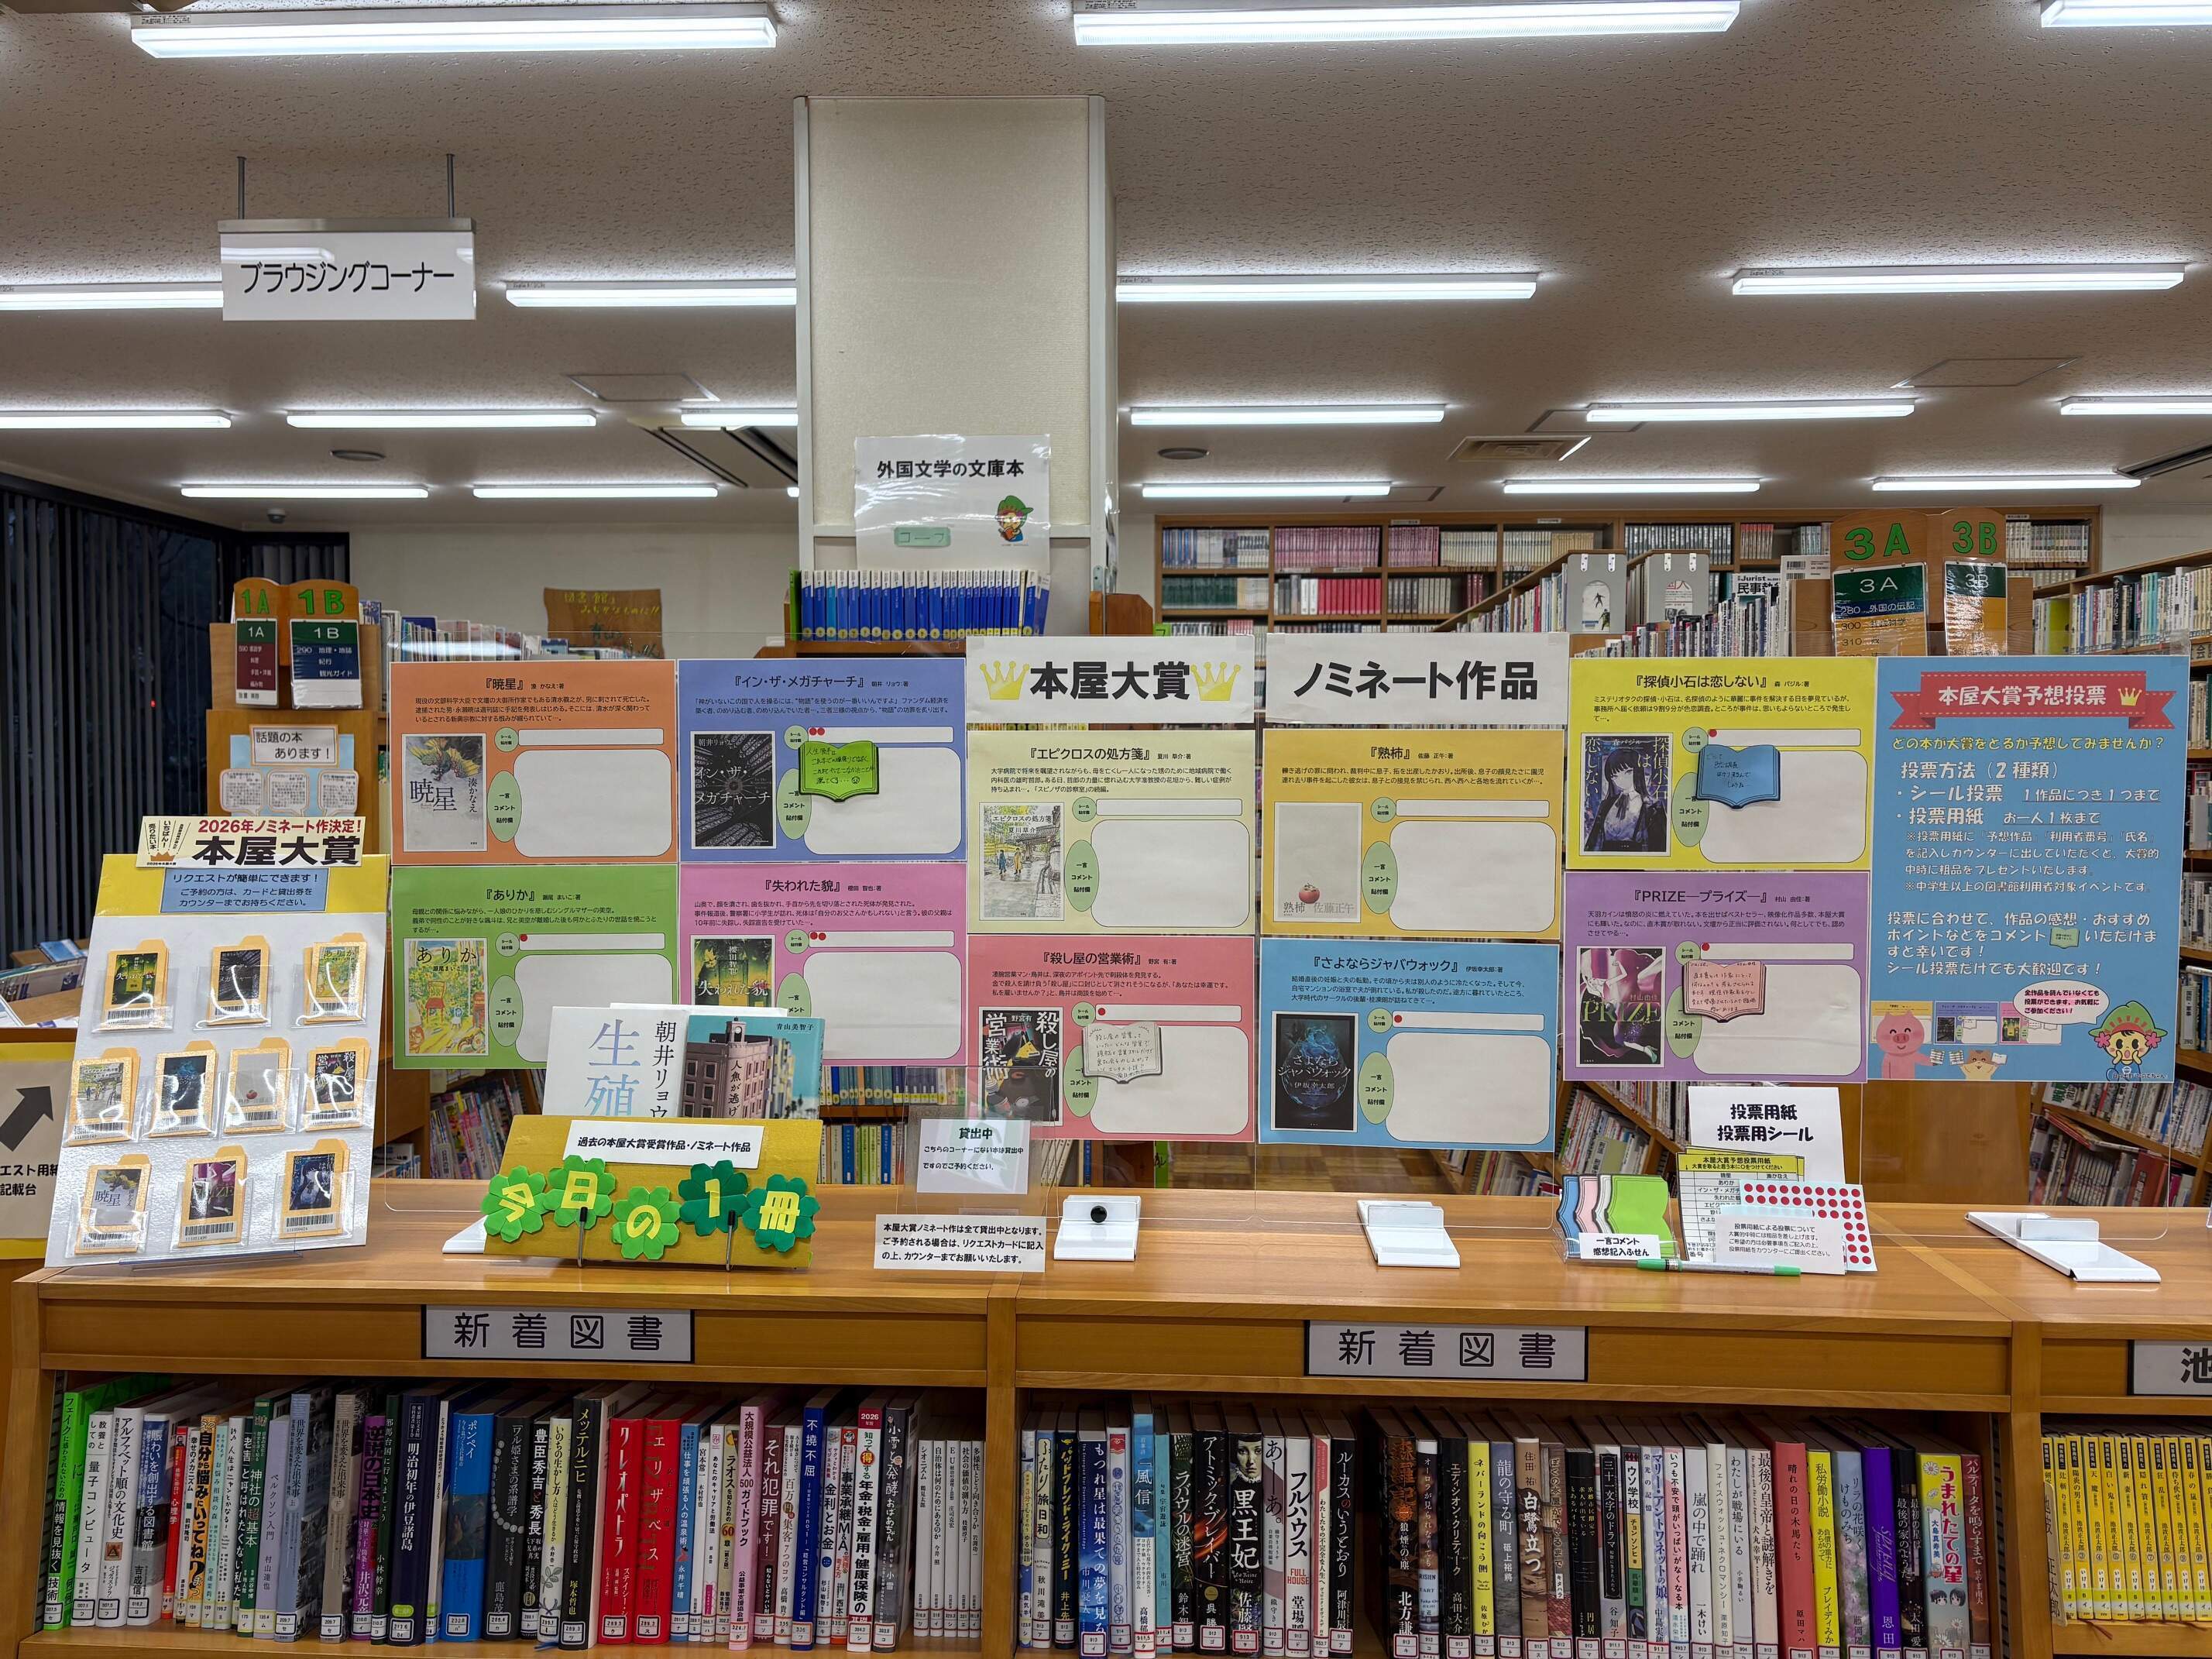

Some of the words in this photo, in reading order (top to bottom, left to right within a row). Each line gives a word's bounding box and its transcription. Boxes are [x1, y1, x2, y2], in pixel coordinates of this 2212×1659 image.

[240, 261, 455, 295] ブラウジングコーナー
[877, 459, 1024, 479] 外国文学の文庫本
[1843, 522, 1911, 561] 3A
[1952, 520, 1997, 555] 3B
[1859, 576, 1898, 593] 3A
[1964, 573, 1990, 589] 3B
[241, 589, 270, 614] 1A
[297, 589, 345, 615] 1B
[248, 627, 265, 638] 1A
[314, 627, 340, 639] 1B
[1841, 621, 1862, 630] 300
[1842, 637, 1863, 647] 310
[486, 678, 524, 690] 『暁星』
[735, 675, 864, 688] 『イン・ザ・メガチャーチ』
[1029, 661, 1190, 700] 本屋大賞
[1293, 660, 1538, 700] ノミネート作品
[1637, 675, 1767, 689] 『探偵小石は恋しない』
[1938, 685, 2107, 707] 本屋大賞予想投票
[256, 732, 304, 743] 話題の本
[1370, 746, 1411, 760] 『熟柿』
[1891, 736, 2165, 751] どの本が大賞をとるか予想してみませんか？
[274, 747, 331, 760] あります！
[1030, 747, 1150, 761] 『エピクロスの処方箋』
[1585, 737, 1601, 796] 恋しない
[1654, 737, 1669, 799] 探偵小石
[410, 778, 458, 812] 暁星
[468, 778, 478, 813] 湊かなえ
[695, 791, 771, 805] メガチャーチ
[2022, 788, 2161, 802] 1作品につき1つまで
[198, 819, 361, 835] 2026年ノミネート作決定！
[2003, 811, 2102, 825] お一人1枚まで
[148, 823, 157, 850] 売りたい本
[192, 836, 360, 867] 本屋大賞
[1905, 847, 2160, 860] を記入しカウンターに出していただくと、大賞的
[173, 872, 319, 885] リクエストが簡単にできます！
[180, 887, 314, 898] ご予約の方は、カードと貸出券を
[765, 879, 840, 892] 『失われた貌』
[179, 898, 308, 908] カウンターまでお持ちください。
[486, 888, 535, 902] 『ありか』
[1887, 911, 2151, 926] 投票に合わせて、作品の感想・おすすめ
[1886, 928, 2047, 943] ポイントなどをコメント
[2083, 929, 2157, 943] いただけま
[417, 946, 477, 964] ありか
[1043, 951, 1141, 966] 『殺し屋の営業術』
[1314, 956, 1458, 974] 『さよならジャバウォック』
[1887, 944, 1985, 959] すと幸いです！
[1886, 961, 2101, 977] シール投票だけでも大歓迎です！
[698, 979, 768, 997] 失われた貌
[2024, 989, 2100, 998] 全作品を読んでいなくても
[775, 1022, 815, 1032] 青山美智子
[1582, 1001, 1661, 1023] PRIZE
[1035, 1012, 1059, 1078] 殺し屋の
[583, 1018, 641, 1116] 生殖
[649, 1020, 676, 1118] 朝井リョウ
[1729, 1104, 1798, 1121] 投票用紙
[577, 1136, 751, 1153] 過去の本屋大賞受賞作品・ノミネート作品
[959, 1127, 993, 1140] 貸出中
[1716, 1125, 1814, 1142] 投票用シール
[923, 1146, 1025, 1155] こちらのコーナーにない本は貸出中
[922, 1162, 994, 1171] ですのでご予約ください。
[0, 1183, 37, 1197] 記載台
[882, 1237, 1045, 1251] ご予約される場合は、リクエストカードに記入
[883, 1223, 1042, 1237] 本屋大賞ノミネート作は全て貸出中となります。
[1595, 1236, 1640, 1245] 一言コメント
[881, 1251, 1024, 1265] の上、カウンターまでお願いいたします。
[1592, 1247, 1650, 1257] 感想記入ふせん
[454, 1312, 664, 1351] 新着図書
[1338, 1328, 1557, 1369] 新着図書
[860, 1413, 880, 1421] 2026
[465, 1420, 478, 1461] ポンペイ
[575, 1407, 590, 1484] メッテルニヒ
[804, 1419, 819, 1478] 不撓不屈
[362, 1425, 386, 1522] 逆説の日本史
[551, 1425, 564, 1496] いのちの生かし方
[698, 1448, 708, 1478] 宮本常一
[919, 1446, 928, 1482] シオニズム
[1524, 1451, 1536, 1488] 住田祐
[111, 1417, 133, 1540] アルファベット順の文化史
[142, 1430, 163, 1552] 賑わいを創出する図書館
[528, 1428, 549, 1536] 豊臣秀吉と秀長
[613, 1427, 631, 1558] クレオパトラ
[738, 1411, 755, 1547] 大規模公益法人500ガイドブック
[934, 1446, 943, 1540] 自治体は何のためにあるのか
[960, 1447, 970, 1515] 社会の価値の測り方
[971, 1447, 981, 1530] 多様性とどう向き合うか
[1626, 1465, 1640, 1510] ウソ学校
[1815, 1463, 1830, 1519] 私労働小説
[2072, 1468, 2081, 1499] 陽炎の男
[2106, 1471, 2115, 1501] 白い鬼
[2172, 1472, 2181, 1501] 待ち伏せ
[246, 1468, 263, 1547] 神社の超基本
[266, 1474, 280, 1540] ベルクソン入門
[400, 1443, 420, 1552] 明治初年の伊豆諸島
[647, 1436, 666, 1561] エリザベス
[678, 1451, 692, 1546] 仕事を頑張る人の温泉術
[1200, 1435, 1224, 1580] アトミック・ブレイバー
[1496, 1459, 1515, 1536] 龍の守る町
[1602, 1459, 1616, 1549] 三十一文字のドラマ
[1730, 1456, 1744, 1557] わたしが戦場にいる
[81, 1461, 100, 1573] 量子コンピュータ
[821, 1483, 837, 1551] 金利とお金
[1060, 1447, 1076, 1581] バッドフレンド・ライク・ミー
[1174, 1472, 1193, 1569] ラバウルの迷宮
[1230, 1489, 1259, 1570] 黒王妃
[1288, 1472, 1310, 1558] フルハウス
[1334, 1451, 1353, 1578] ルーカスのいうとおり
[1449, 1463, 1463, 1577] エディシオン・クリティーク
[1475, 1458, 1489, 1574] ネバーランドの向こう側
[1650, 1452, 1668, 1600] マリー・アントワネットの娘
[1757, 1451, 1775, 1595] 最後の皇帝と謎解きを
[1840, 1483, 1853, 1545] けものみち
[1939, 1465, 1963, 1585] うまれたての星
[853, 1479, 874, 1614] 年金・税金・雇用・健康保険の
[1523, 1492, 1542, 1574] 白鷺立つ
[1689, 1492, 1707, 1574] 嵐の中で踊れ
[1715, 1462, 1728, 1609] フェイスウォッシュ・ネクロマンシー
[1787, 1464, 1802, 1562] 晴れの日の木馬たち
[1795, 1609, 1806, 1643] 原田マハ
[1286, 1576, 1310, 1586] HOUSE
[1290, 1568, 1307, 1577] FULL
[1554, 1573, 1565, 1599] キタハラ
[1695, 1602, 1708, 1637] 一木けい
[1882, 1615, 1895, 1646] 恩田
